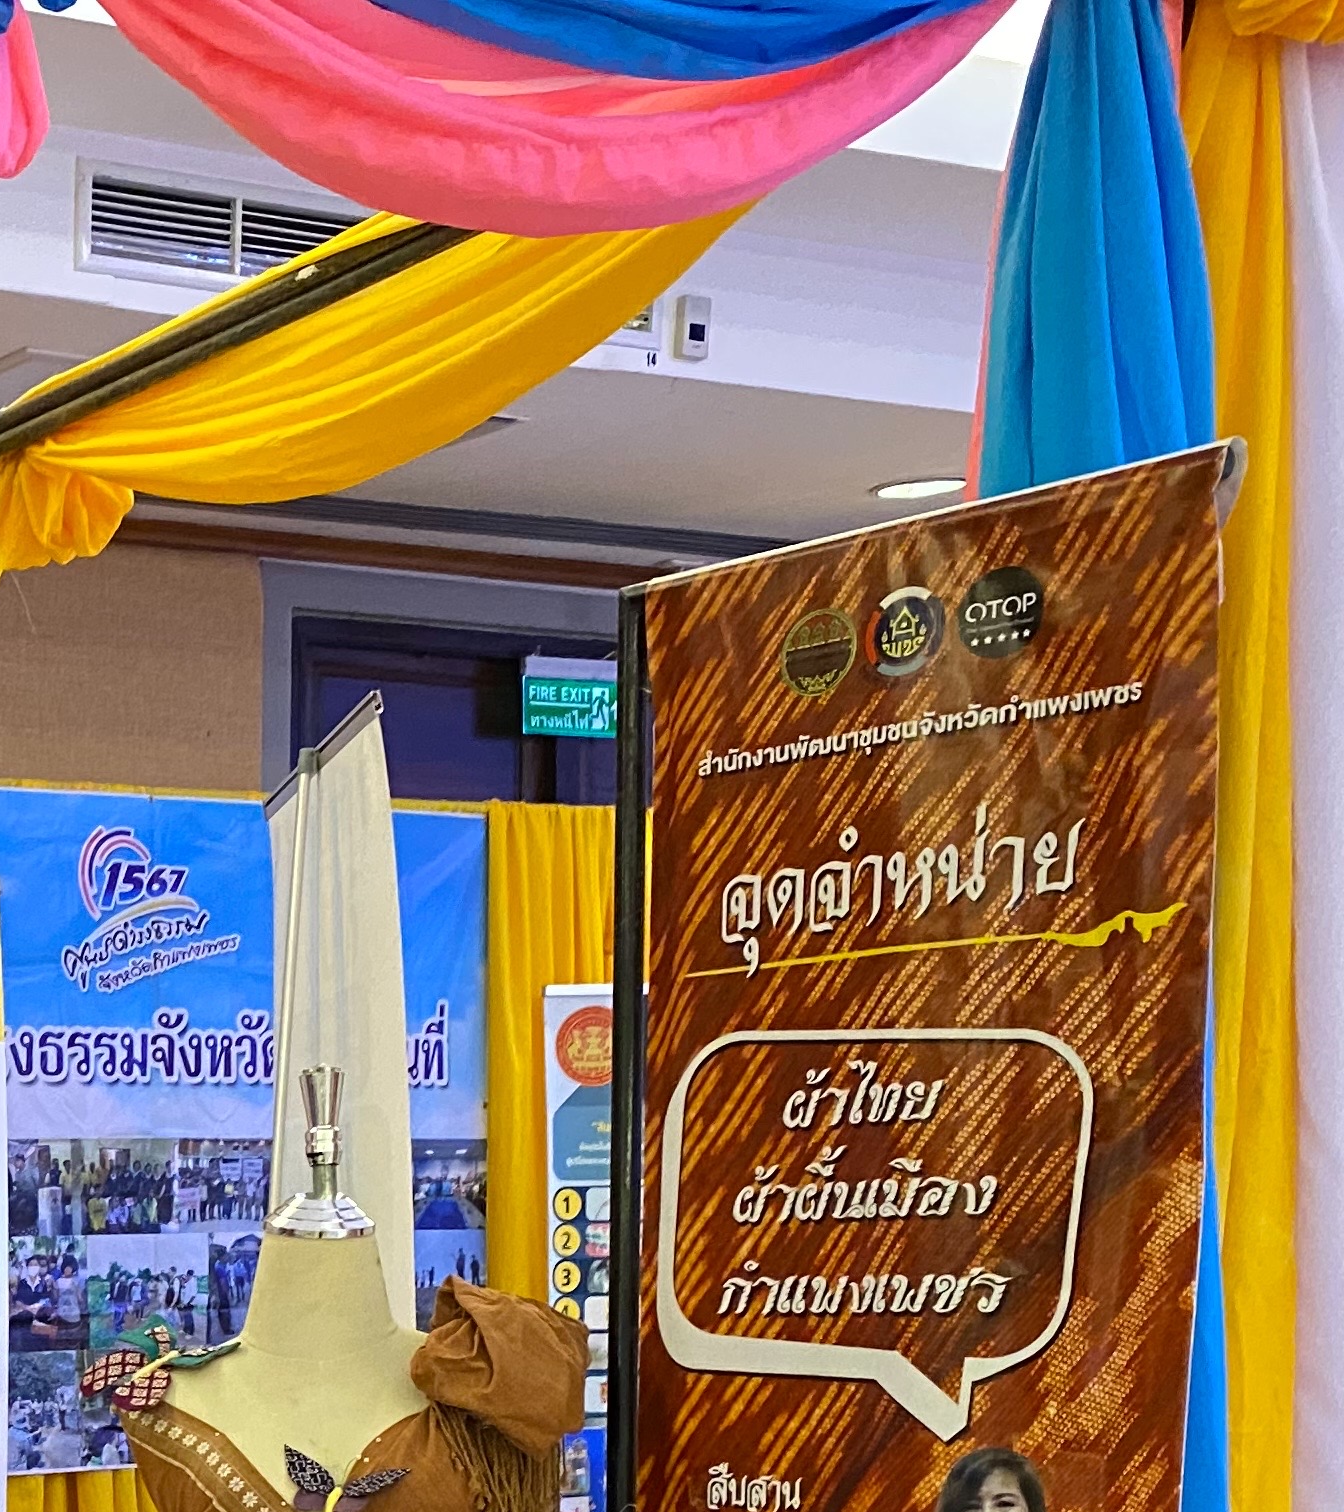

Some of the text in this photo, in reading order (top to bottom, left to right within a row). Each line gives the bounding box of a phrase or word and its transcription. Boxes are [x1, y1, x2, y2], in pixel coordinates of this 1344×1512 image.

[964, 591, 1038, 623] OTOP
[528, 685, 591, 702] FIRE EXIT
[530, 709, 590, 730] ทางหนีไฟ
[698, 681, 1144, 778] สำนักงานพัฒนาชุมชนจังหวัดกำแพงเพชร
[100, 861, 186, 908] 1567
[722, 801, 1087, 977] จุดจำหน่าย
[782, 1060, 945, 1130] ผ้าไทย
[563, 1196, 571, 1214] 1
[562, 1232, 572, 1250] 2
[561, 1268, 572, 1287] 3
[716, 1259, 1014, 1317] กำแพงเพชร
